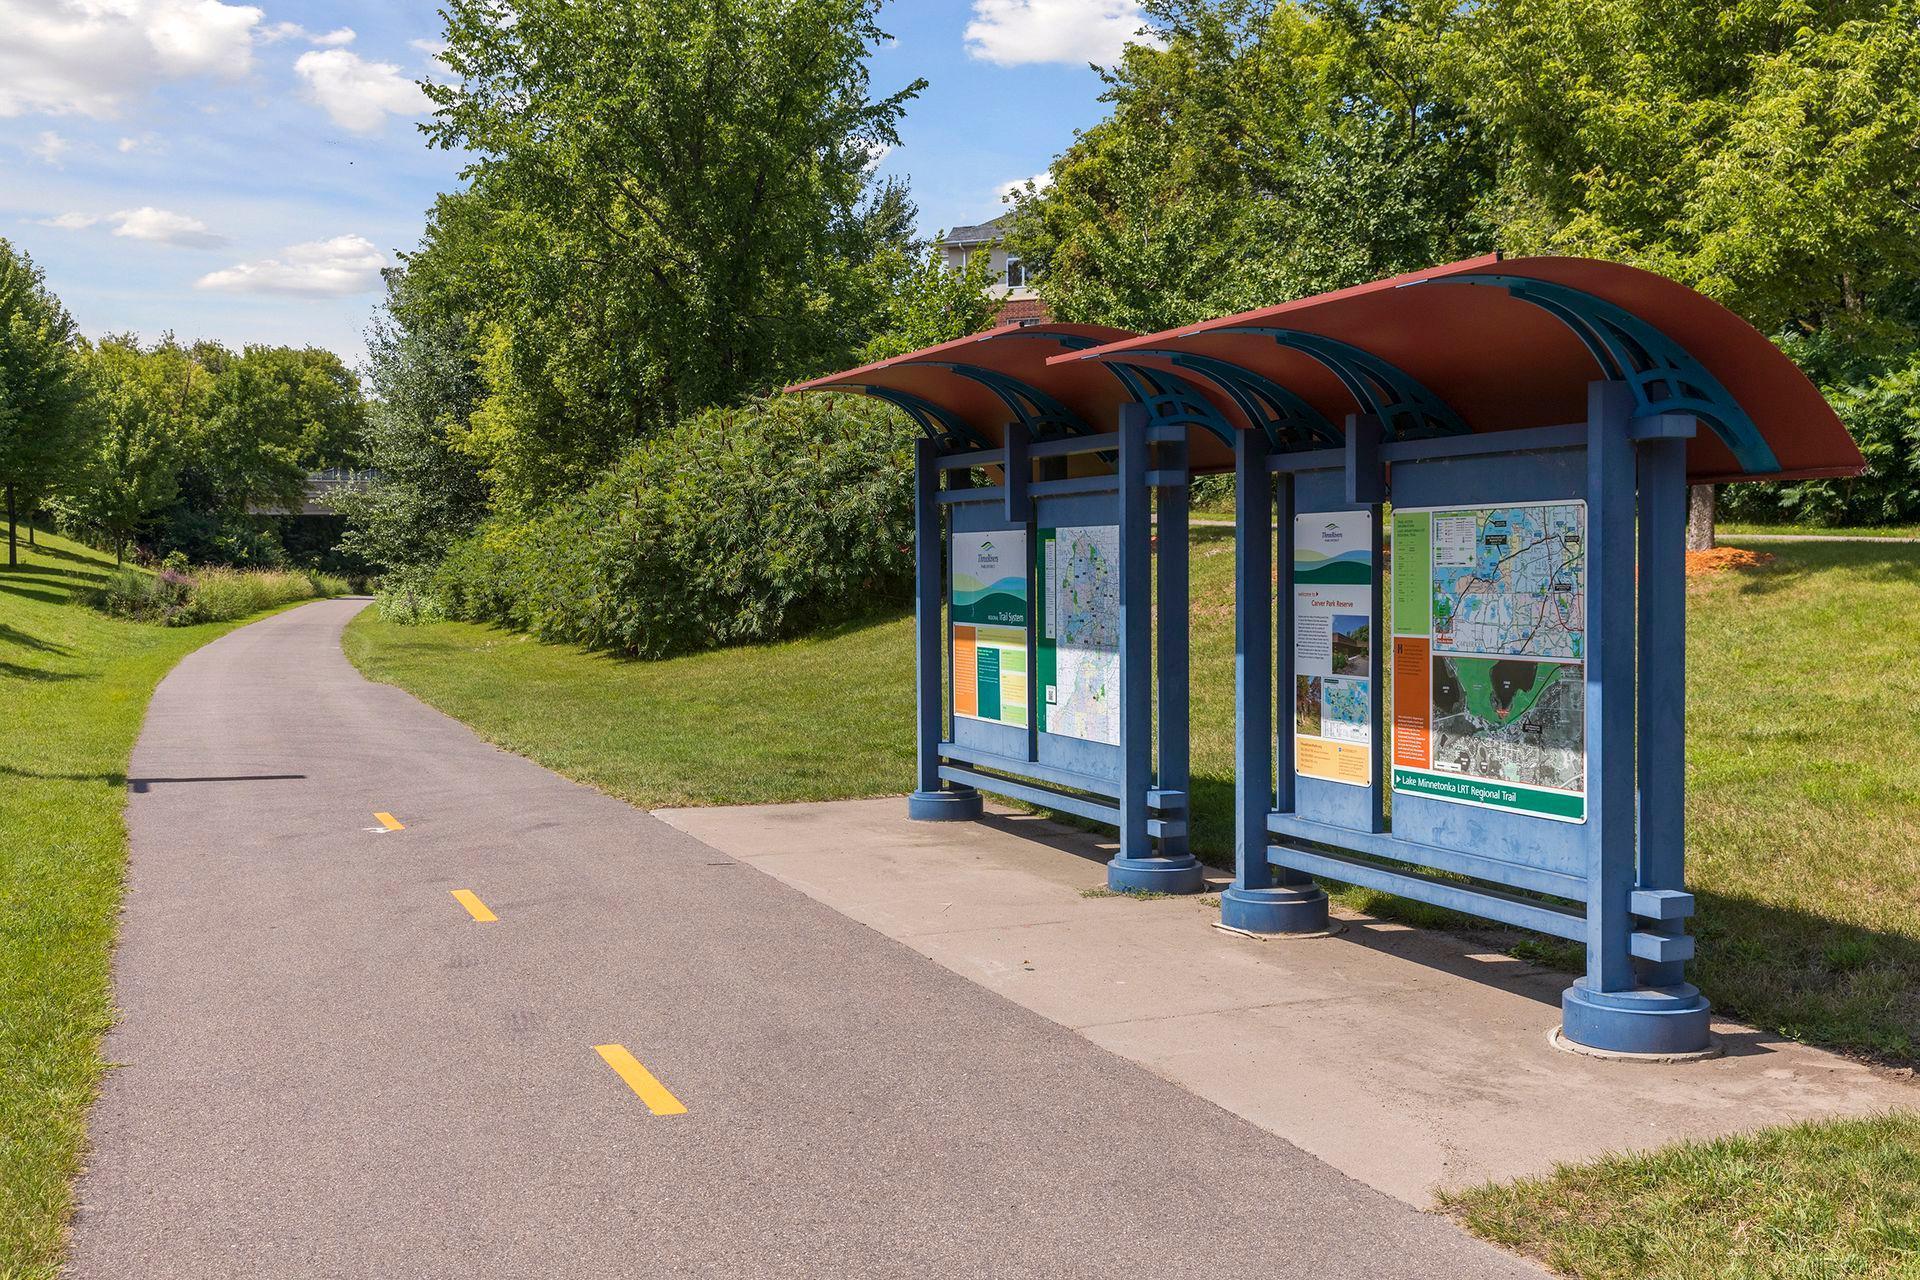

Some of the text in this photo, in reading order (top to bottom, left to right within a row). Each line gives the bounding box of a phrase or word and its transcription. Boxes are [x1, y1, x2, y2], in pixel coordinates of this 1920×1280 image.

[999, 611, 1008, 621] Trail
[1009, 612, 1024, 623] System
[1402, 775, 1517, 802] Lake Minnetonka LRT Regional Trail
